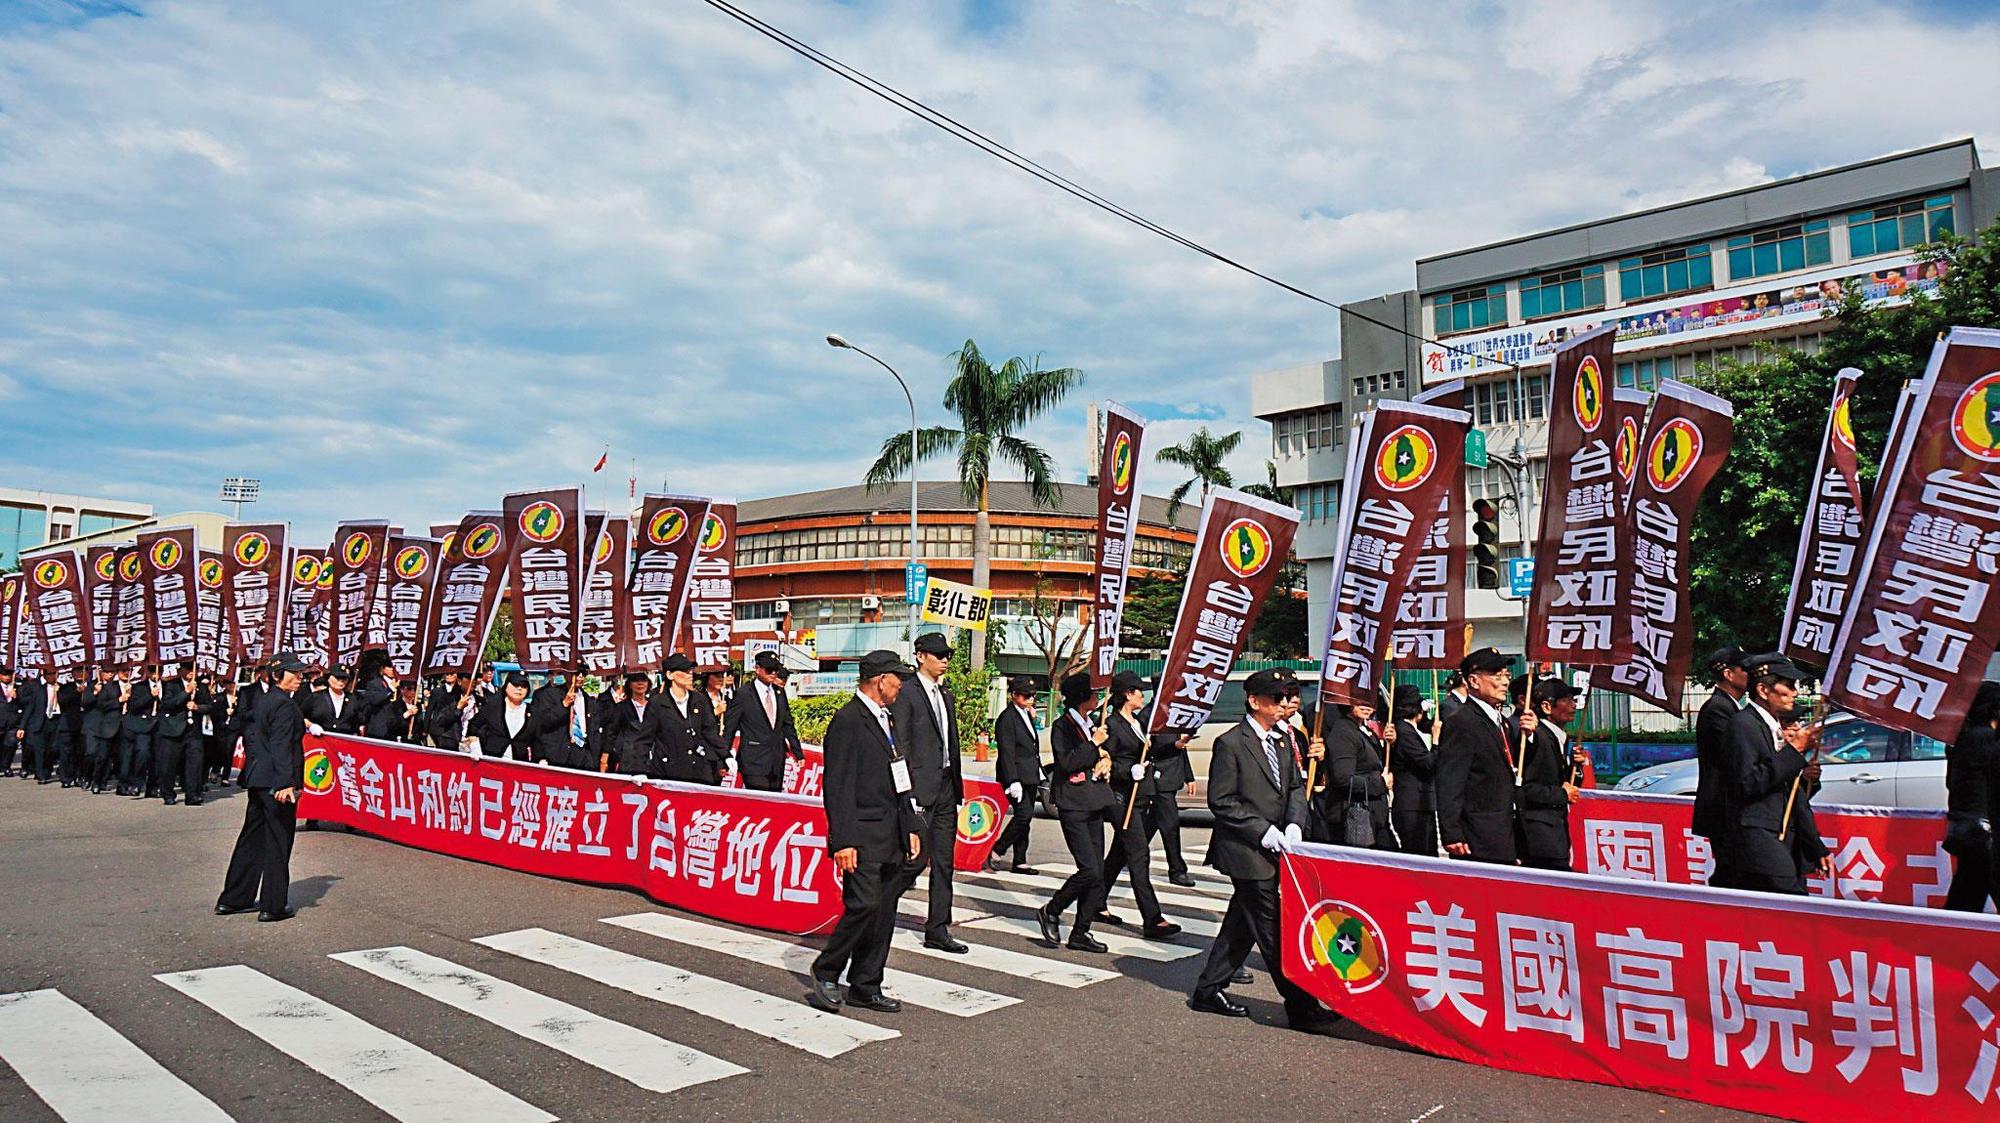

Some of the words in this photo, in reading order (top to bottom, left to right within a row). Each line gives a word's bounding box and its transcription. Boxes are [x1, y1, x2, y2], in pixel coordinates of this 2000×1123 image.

[1427, 351, 1446, 373] 賀
[153, 573, 195, 661] 台灣民政府
[428, 563, 492, 668] 台灣民政府
[520, 547, 572, 662] 台灣民政府
[632, 550, 679, 665] 台灣民政府
[689, 556, 734, 666] 台灣民政府
[927, 588, 988, 622] 彰化郡
[1516, 562, 1534, 577] P
[38, 590, 86, 667] 台灣民政府
[578, 571, 616, 671] 台灣民政府
[338, 751, 828, 904] 舊金山和約已經確立了台灣地位
